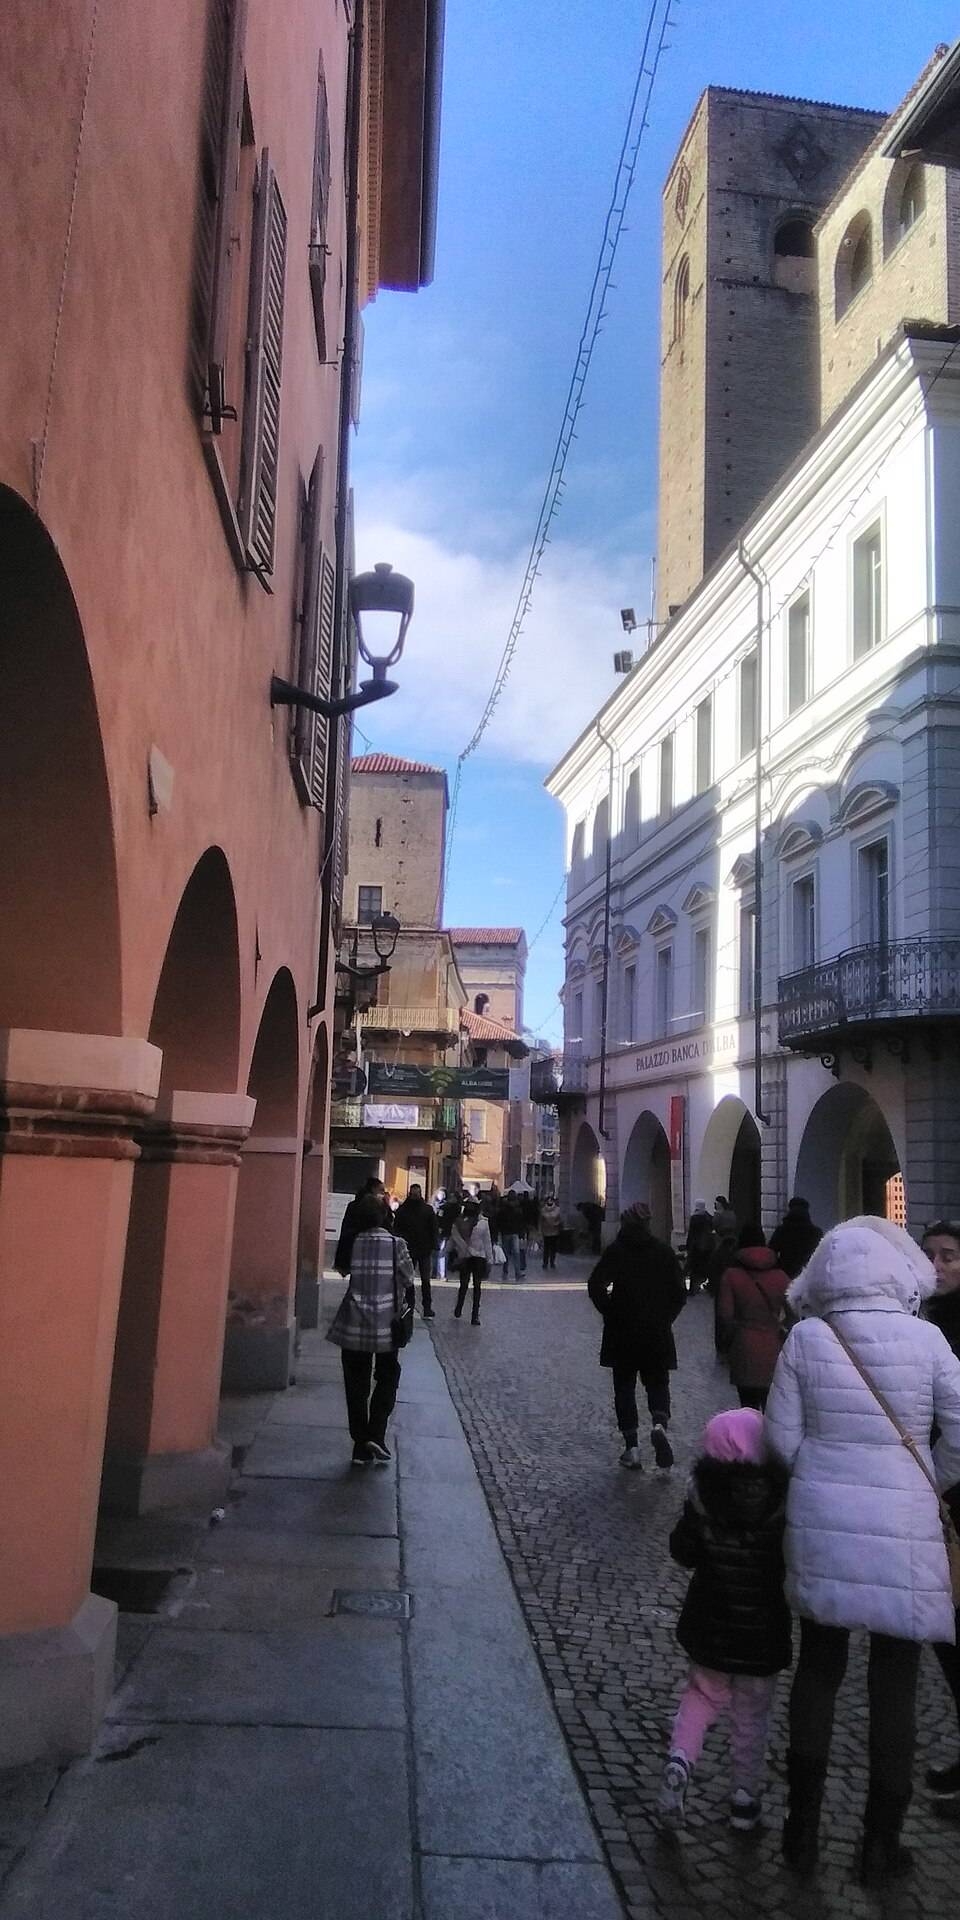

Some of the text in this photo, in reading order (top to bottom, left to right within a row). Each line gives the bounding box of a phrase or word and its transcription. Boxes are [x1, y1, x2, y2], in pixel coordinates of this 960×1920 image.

[635, 1034, 736, 1072] PALAZZO BANCA D'ALBA
